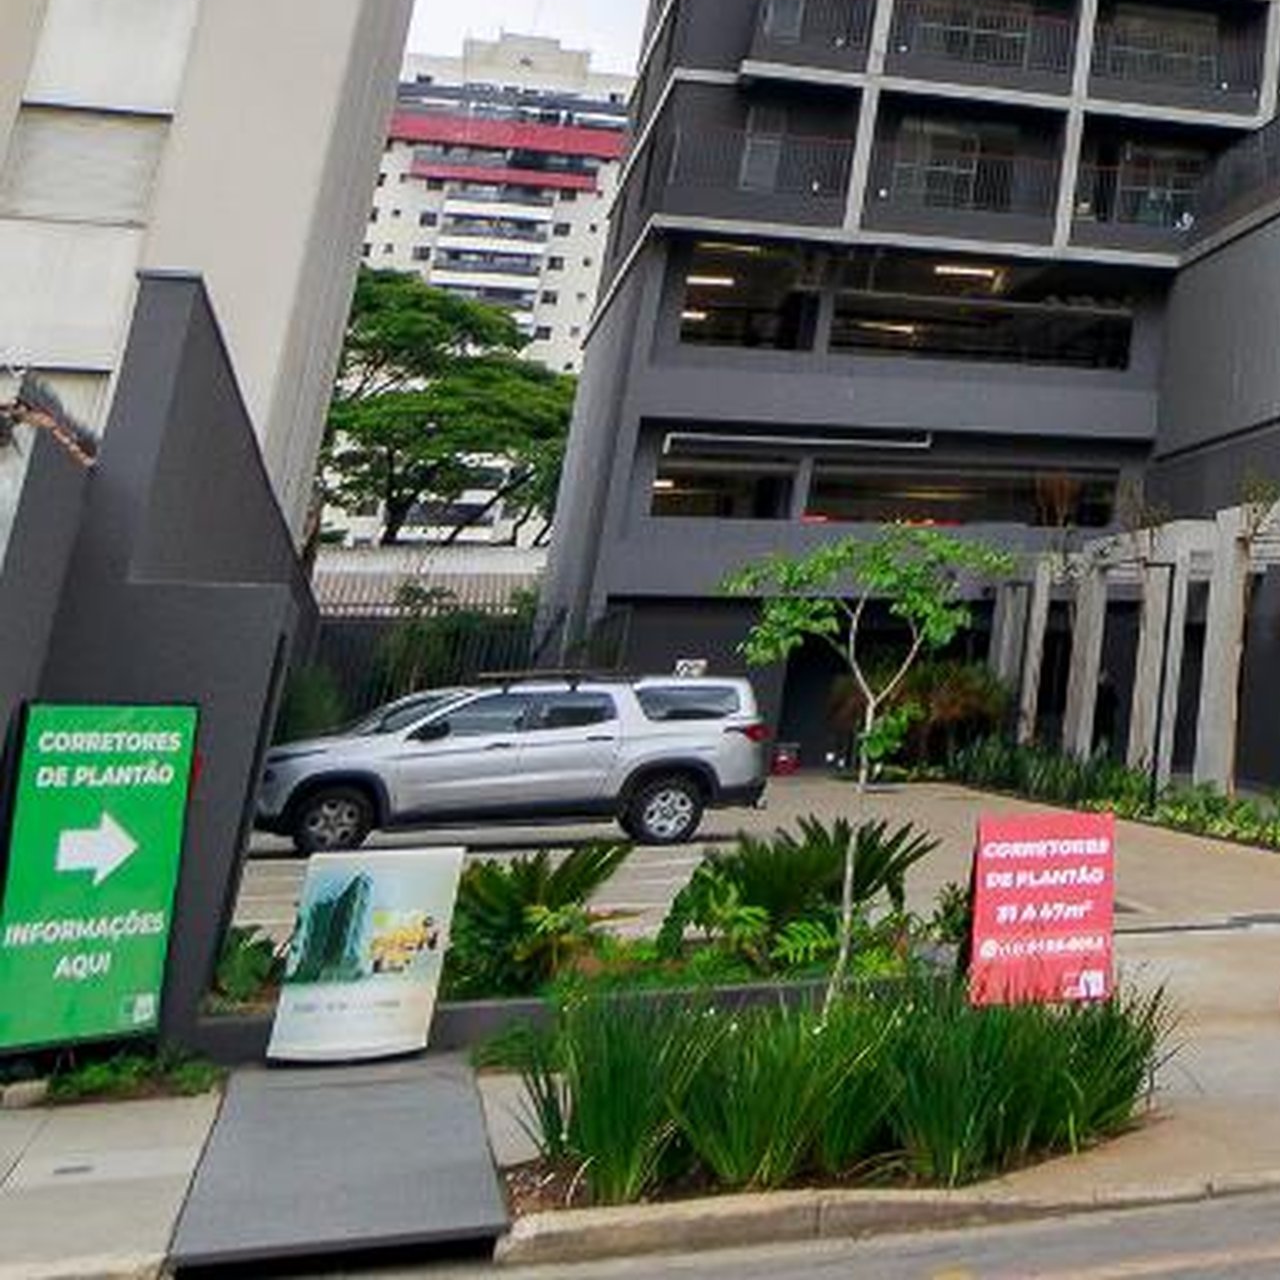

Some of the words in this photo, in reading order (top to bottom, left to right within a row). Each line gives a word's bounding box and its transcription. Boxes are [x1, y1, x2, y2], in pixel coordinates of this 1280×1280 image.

[38, 730, 182, 753] CORRETORES
[36, 766, 68, 788] DE
[71, 759, 174, 787] PLANTÃO
[983, 837, 1110, 859] CORRETORES
[985, 871, 1013, 889] DE
[1015, 864, 1105, 888] PLANTÃO
[3, 907, 165, 948] INFORMAÇÕES
[53, 951, 112, 980] AQUI
